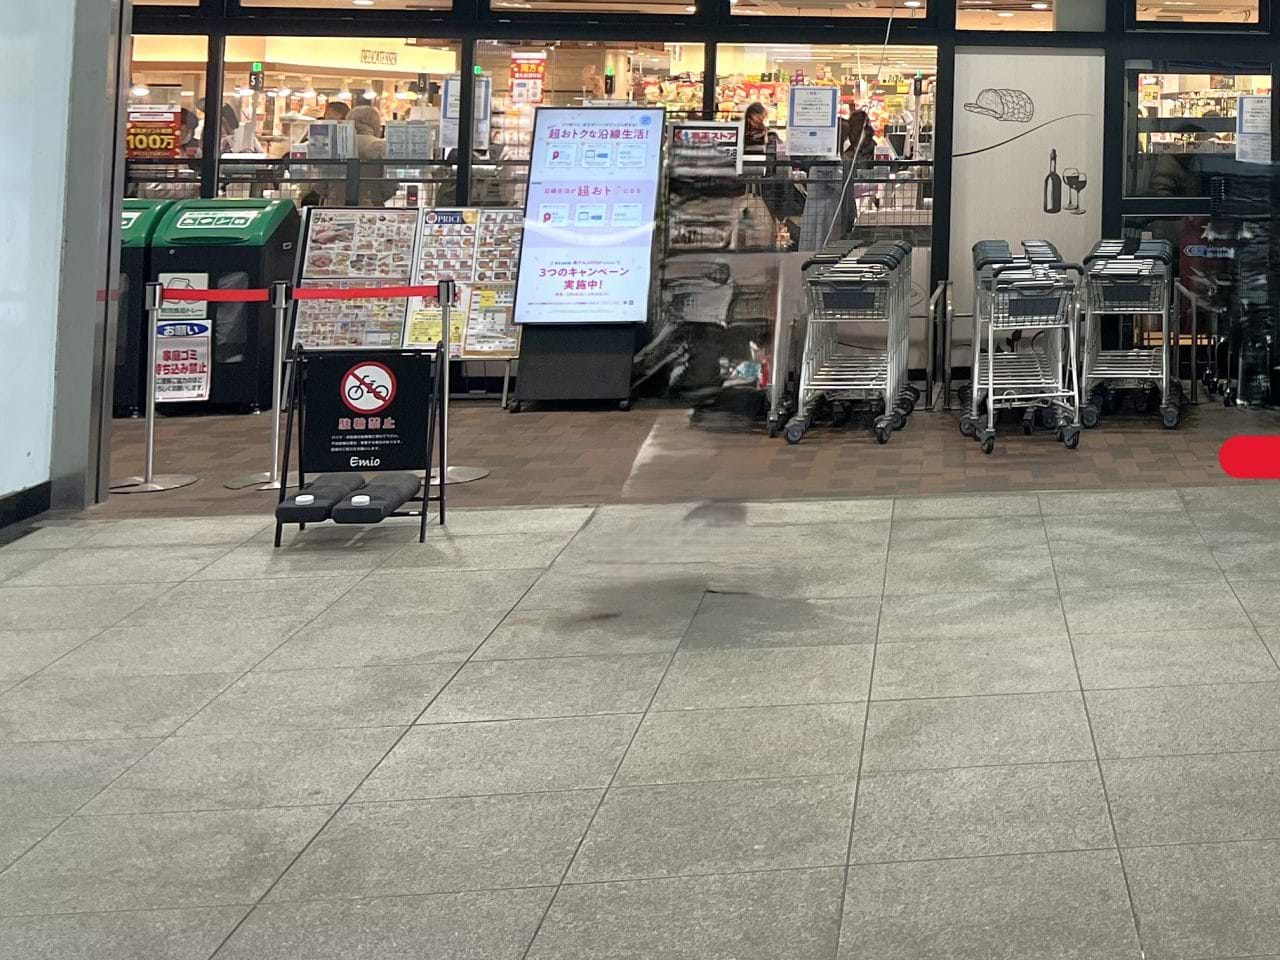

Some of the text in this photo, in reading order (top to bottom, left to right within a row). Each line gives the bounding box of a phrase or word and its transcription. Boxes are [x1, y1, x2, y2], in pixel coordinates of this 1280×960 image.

[127, 135, 176, 149] 100万
[437, 215, 462, 224] PRICE
[539, 267, 630, 278] 3つのキャンペーン
[564, 279, 603, 290] 実施中!
[163, 325, 199, 336] お願い
[163, 349, 198, 362] 家庭ゴミ
[350, 456, 381, 467] Emio
